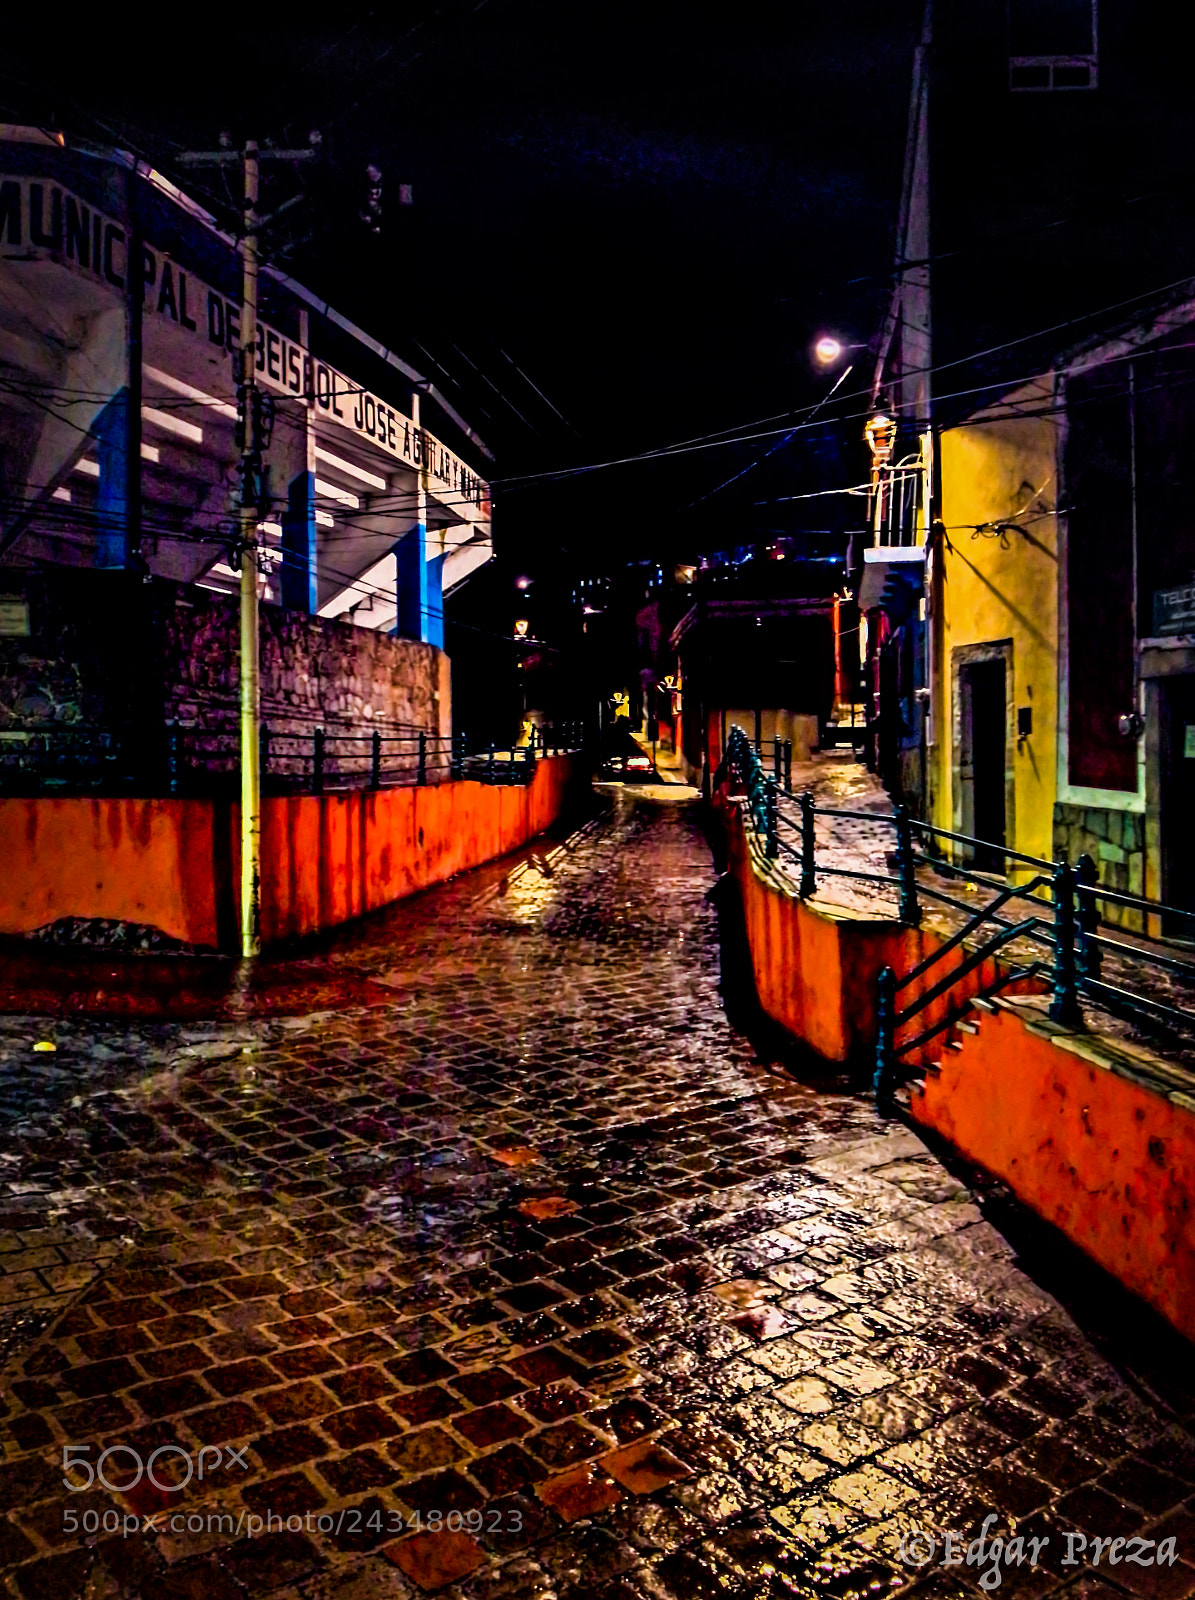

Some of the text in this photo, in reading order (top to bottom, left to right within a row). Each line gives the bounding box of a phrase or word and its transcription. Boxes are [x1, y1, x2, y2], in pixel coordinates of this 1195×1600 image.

[0, 180, 197, 332] MUNICPAL
[208, 290, 242, 352] DE
[256, 322, 344, 418] BEISBOL
[354, 391, 396, 450] JOSE
